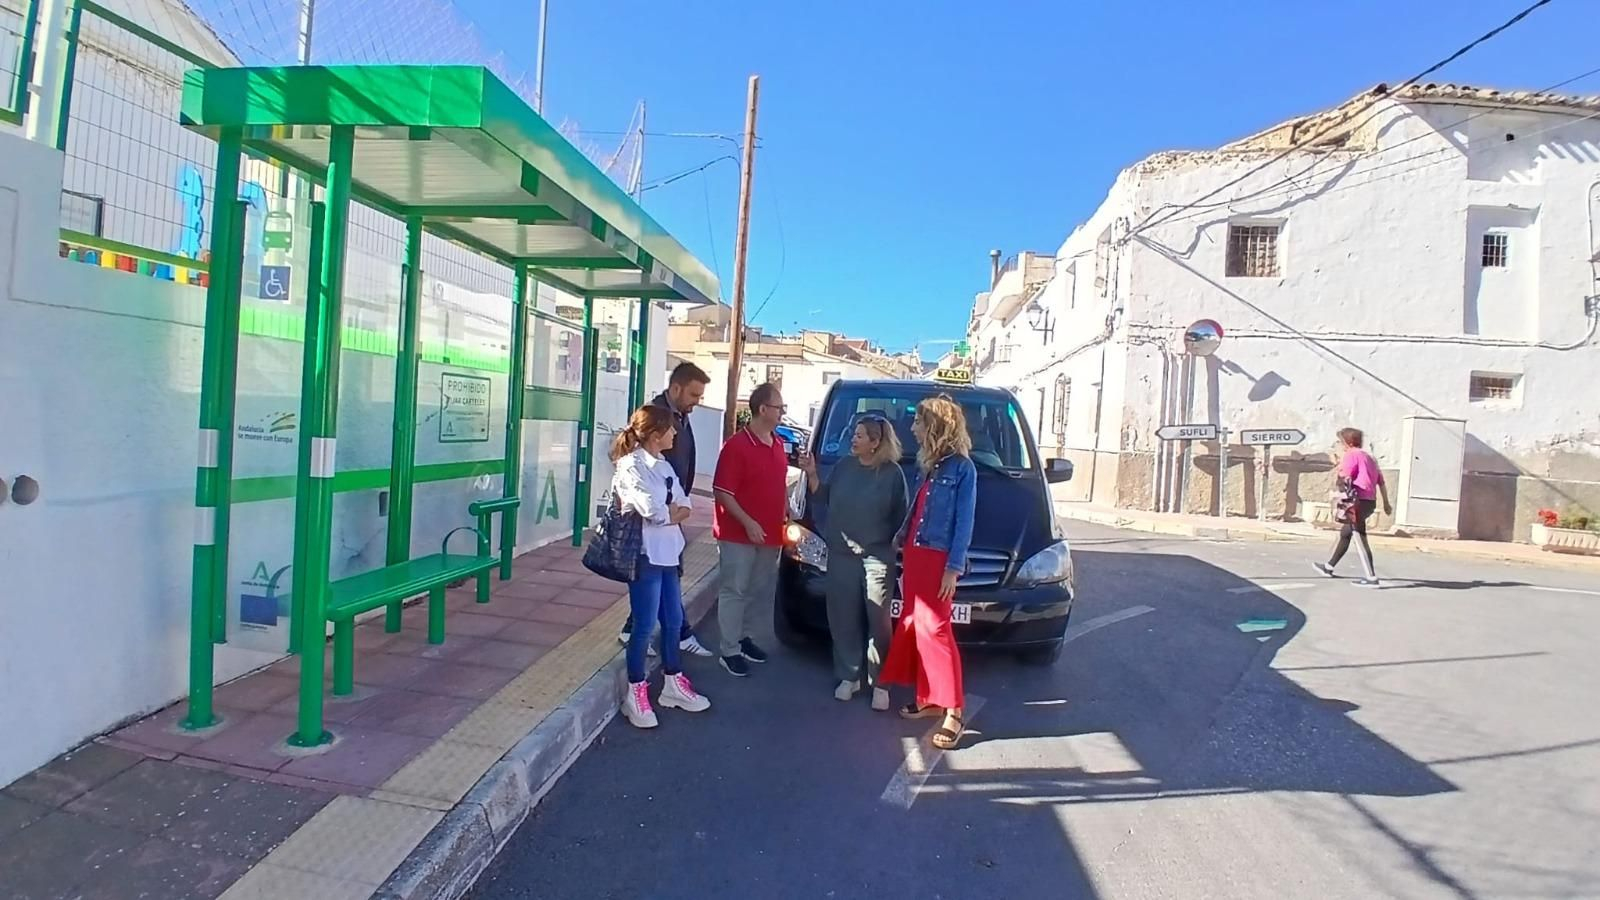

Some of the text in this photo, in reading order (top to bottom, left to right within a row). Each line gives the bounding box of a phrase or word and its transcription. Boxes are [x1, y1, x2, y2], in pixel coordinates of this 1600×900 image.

[940, 370, 968, 379] TAXI
[447, 380, 487, 393] PROHIBIDO
[1180, 428, 1208, 437] SUFLI
[1251, 433, 1292, 442] SIERRO
